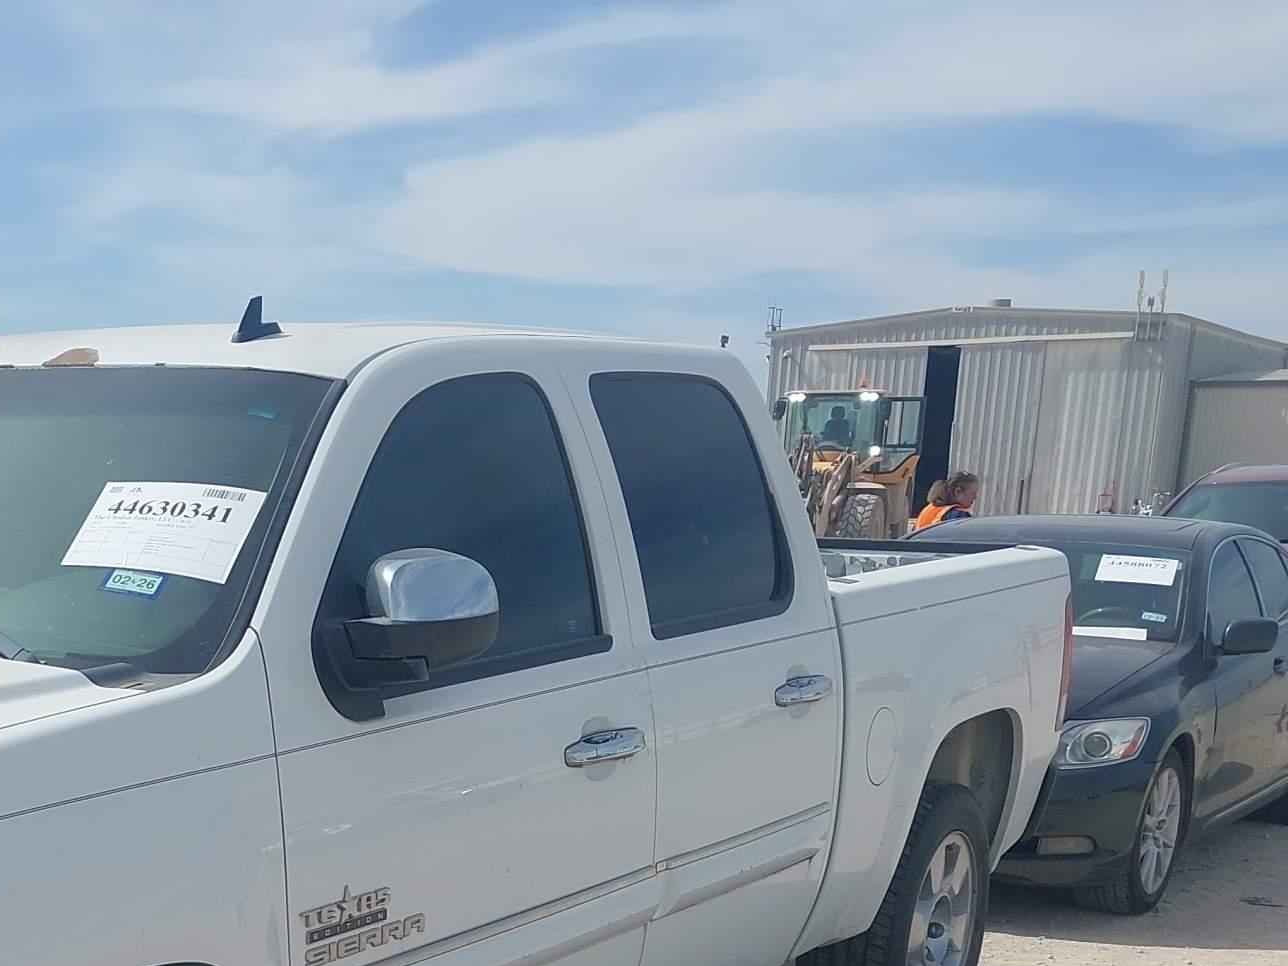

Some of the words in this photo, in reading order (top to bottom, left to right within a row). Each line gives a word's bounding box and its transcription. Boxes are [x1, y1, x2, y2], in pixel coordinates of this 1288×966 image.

[108, 499, 233, 524] 44630341
[299, 885, 392, 928] TEXAS
[312, 912, 386, 941] EDITION
